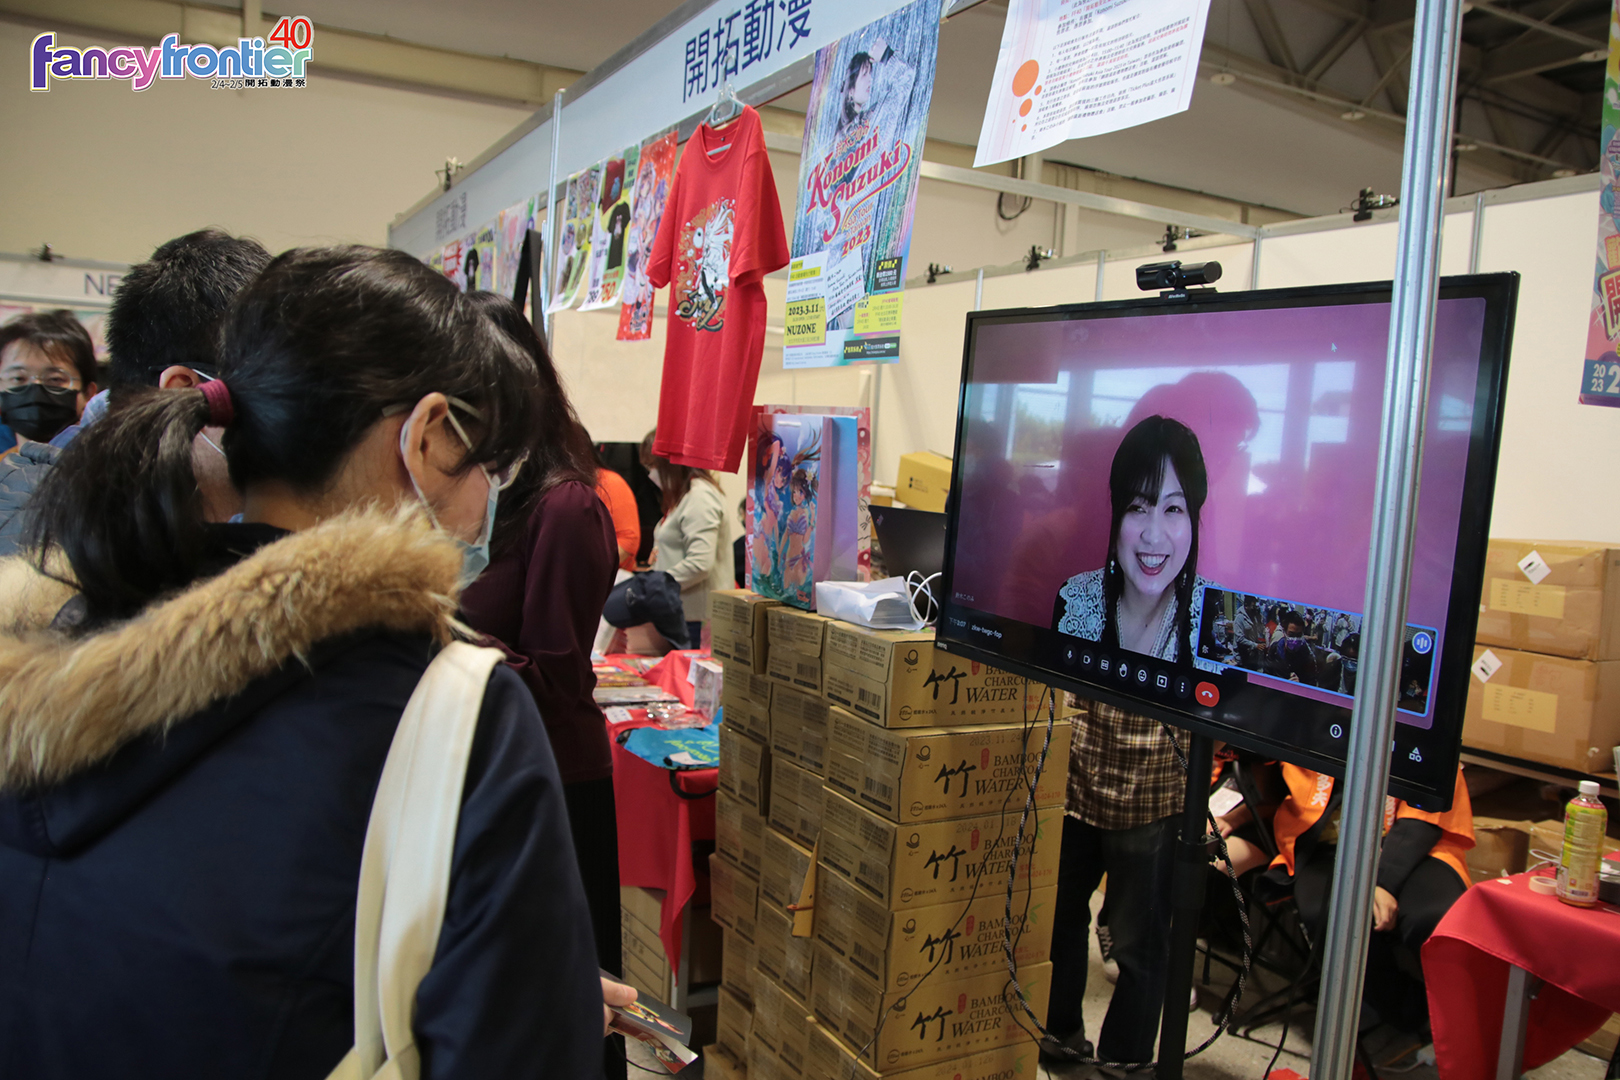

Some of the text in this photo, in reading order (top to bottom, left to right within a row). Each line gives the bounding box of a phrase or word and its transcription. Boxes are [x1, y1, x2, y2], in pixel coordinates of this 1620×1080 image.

[683, 0, 812, 104] 開拓動漫
[806, 125, 880, 216] Konomi
[822, 138, 912, 245] Suzuki
[841, 224, 872, 258] 2023
[788, 303, 819, 316] 2023.3.11
[786, 323, 817, 336] NUZONE
[1591, 378, 1604, 392] 23
[1593, 363, 1606, 378] 20
[923, 665, 967, 704] 竹
[966, 687, 1018, 704] WATER
[934, 760, 977, 798] 竹
[975, 777, 1025, 796] WATER
[924, 845, 967, 883] 竹
[920, 928, 961, 964] 竹
[910, 1006, 953, 1042] 竹
[952, 1017, 1001, 1038] WATER
